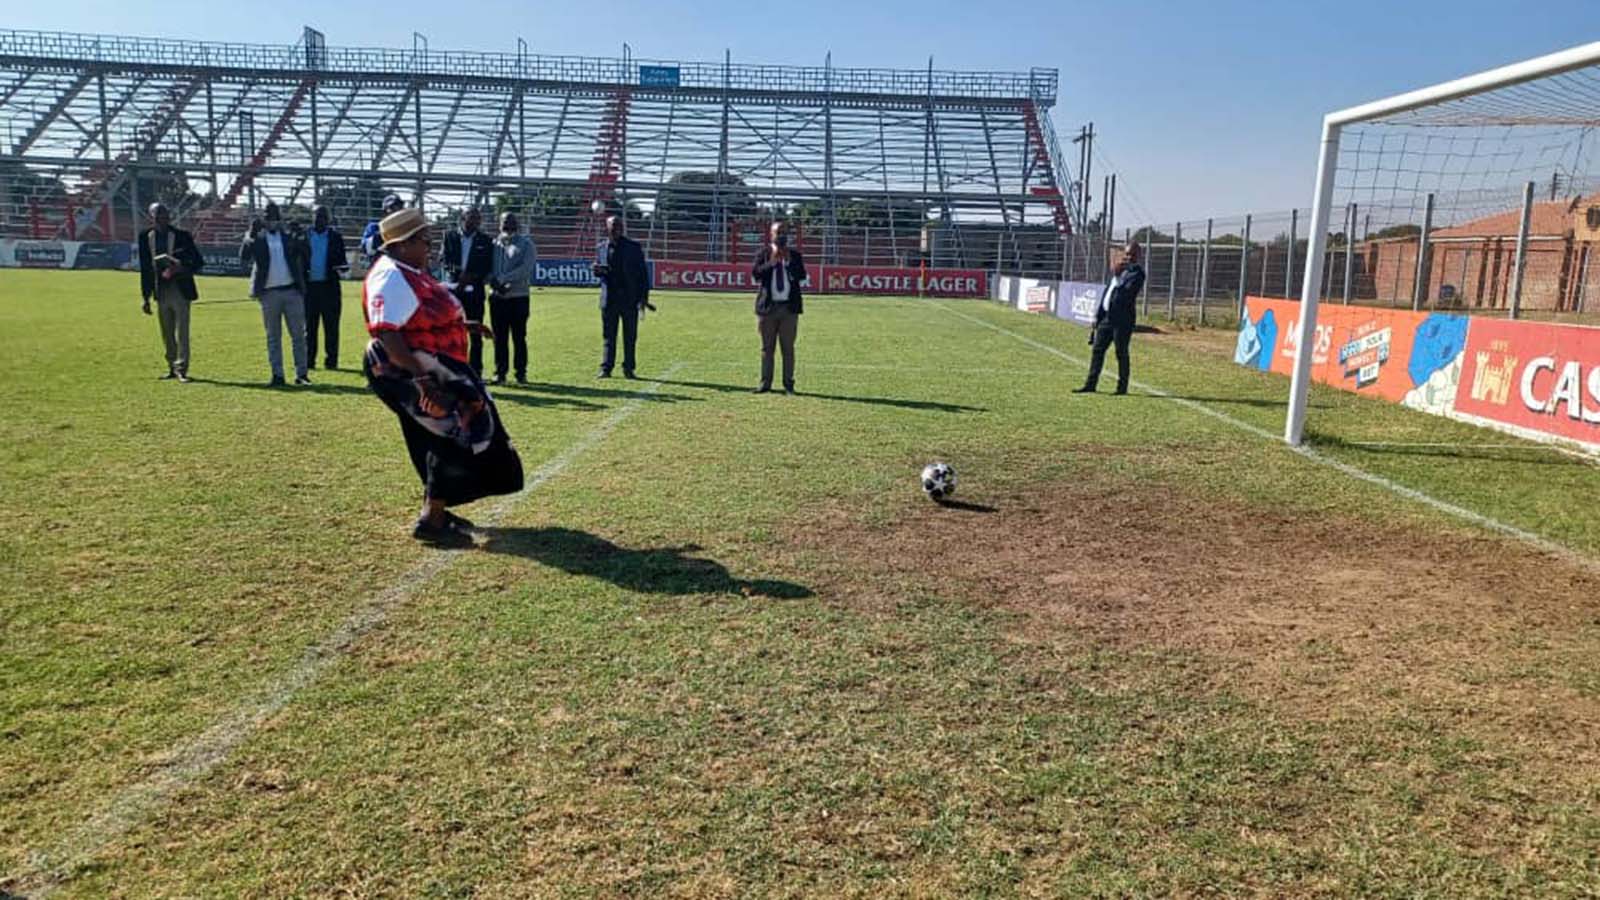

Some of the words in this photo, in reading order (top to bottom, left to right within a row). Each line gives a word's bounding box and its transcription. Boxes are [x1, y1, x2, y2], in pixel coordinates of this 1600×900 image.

[681, 271, 746, 286] CASTLE
[849, 275, 911, 290] CASTLE
[917, 277, 977, 292] LAGER
